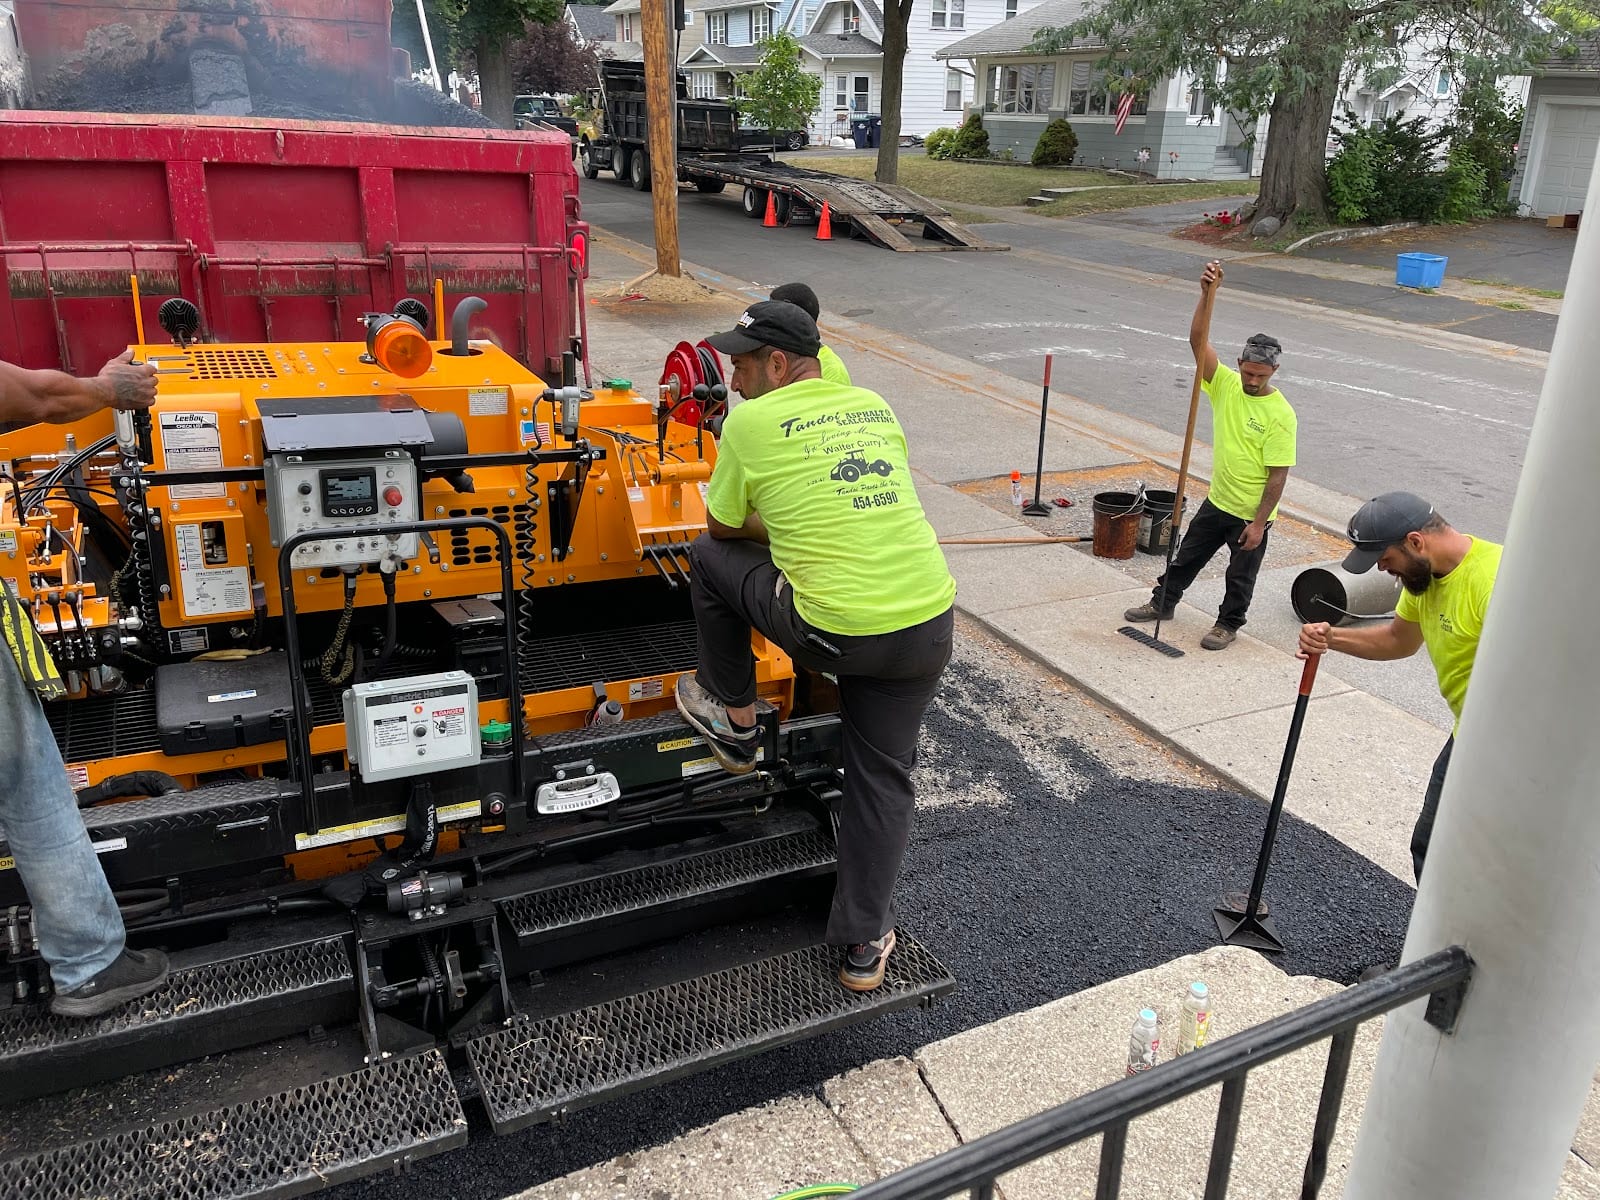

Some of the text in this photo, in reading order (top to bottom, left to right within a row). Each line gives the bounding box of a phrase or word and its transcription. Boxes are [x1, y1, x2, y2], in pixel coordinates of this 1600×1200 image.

[175, 414, 203, 423] LeeBoy
[846, 409, 884, 419] ASPHALT
[780, 412, 840, 437] Tandoi
[836, 415, 895, 426] SEALCOATING
[823, 439, 881, 455] Walter Curry
[853, 490, 899, 510] 454-6590
[391, 689, 444, 702] Electric Heat
[438, 708, 464, 716] DANGER
[665, 739, 692, 749] CAUTION
